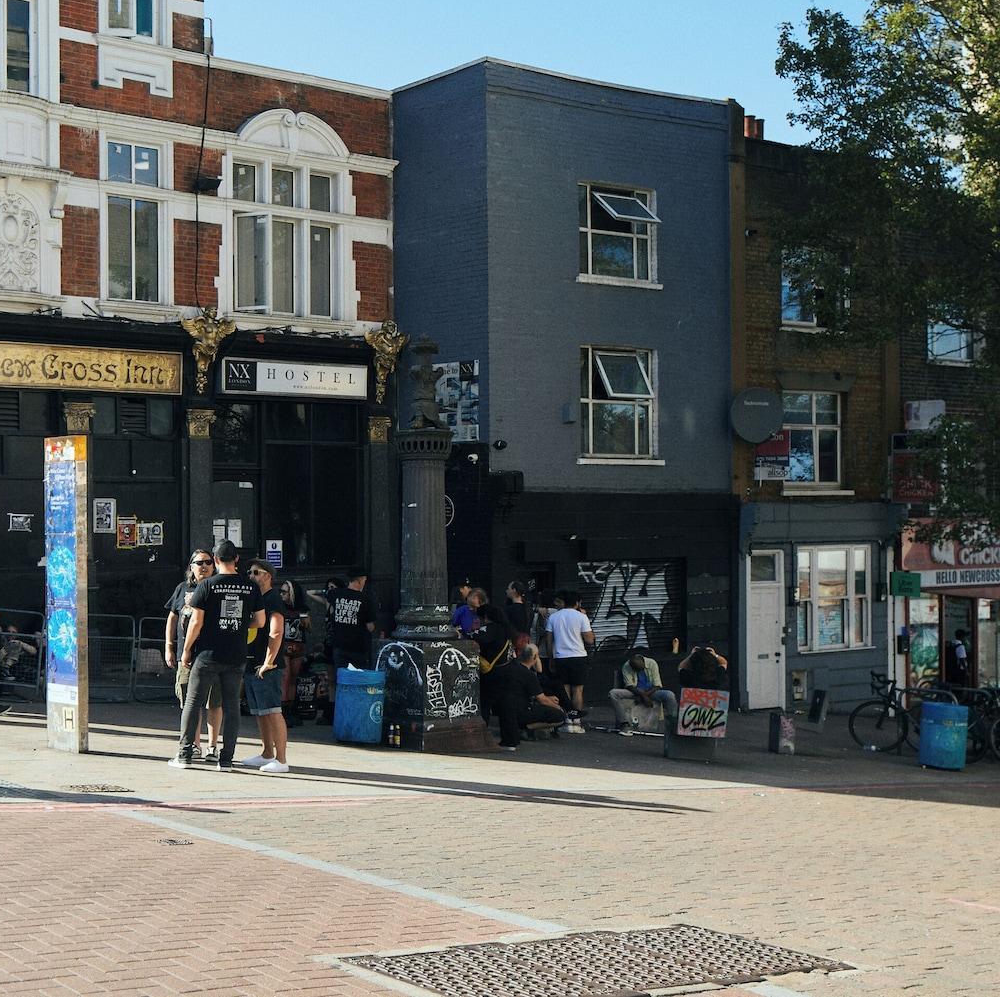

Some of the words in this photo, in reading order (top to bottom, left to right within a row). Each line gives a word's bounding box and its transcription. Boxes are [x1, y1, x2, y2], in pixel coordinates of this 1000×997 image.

[41, 353, 118, 383] Cross
[124, 357, 165, 385] Inn
[228, 362, 251, 379] NX
[266, 368, 356, 385] HOSTEL
[936, 571, 957, 584] HELLO
[335, 609, 353, 618] LIFE
[335, 615, 358, 625] DEATH
[64, 709, 74, 729] H
